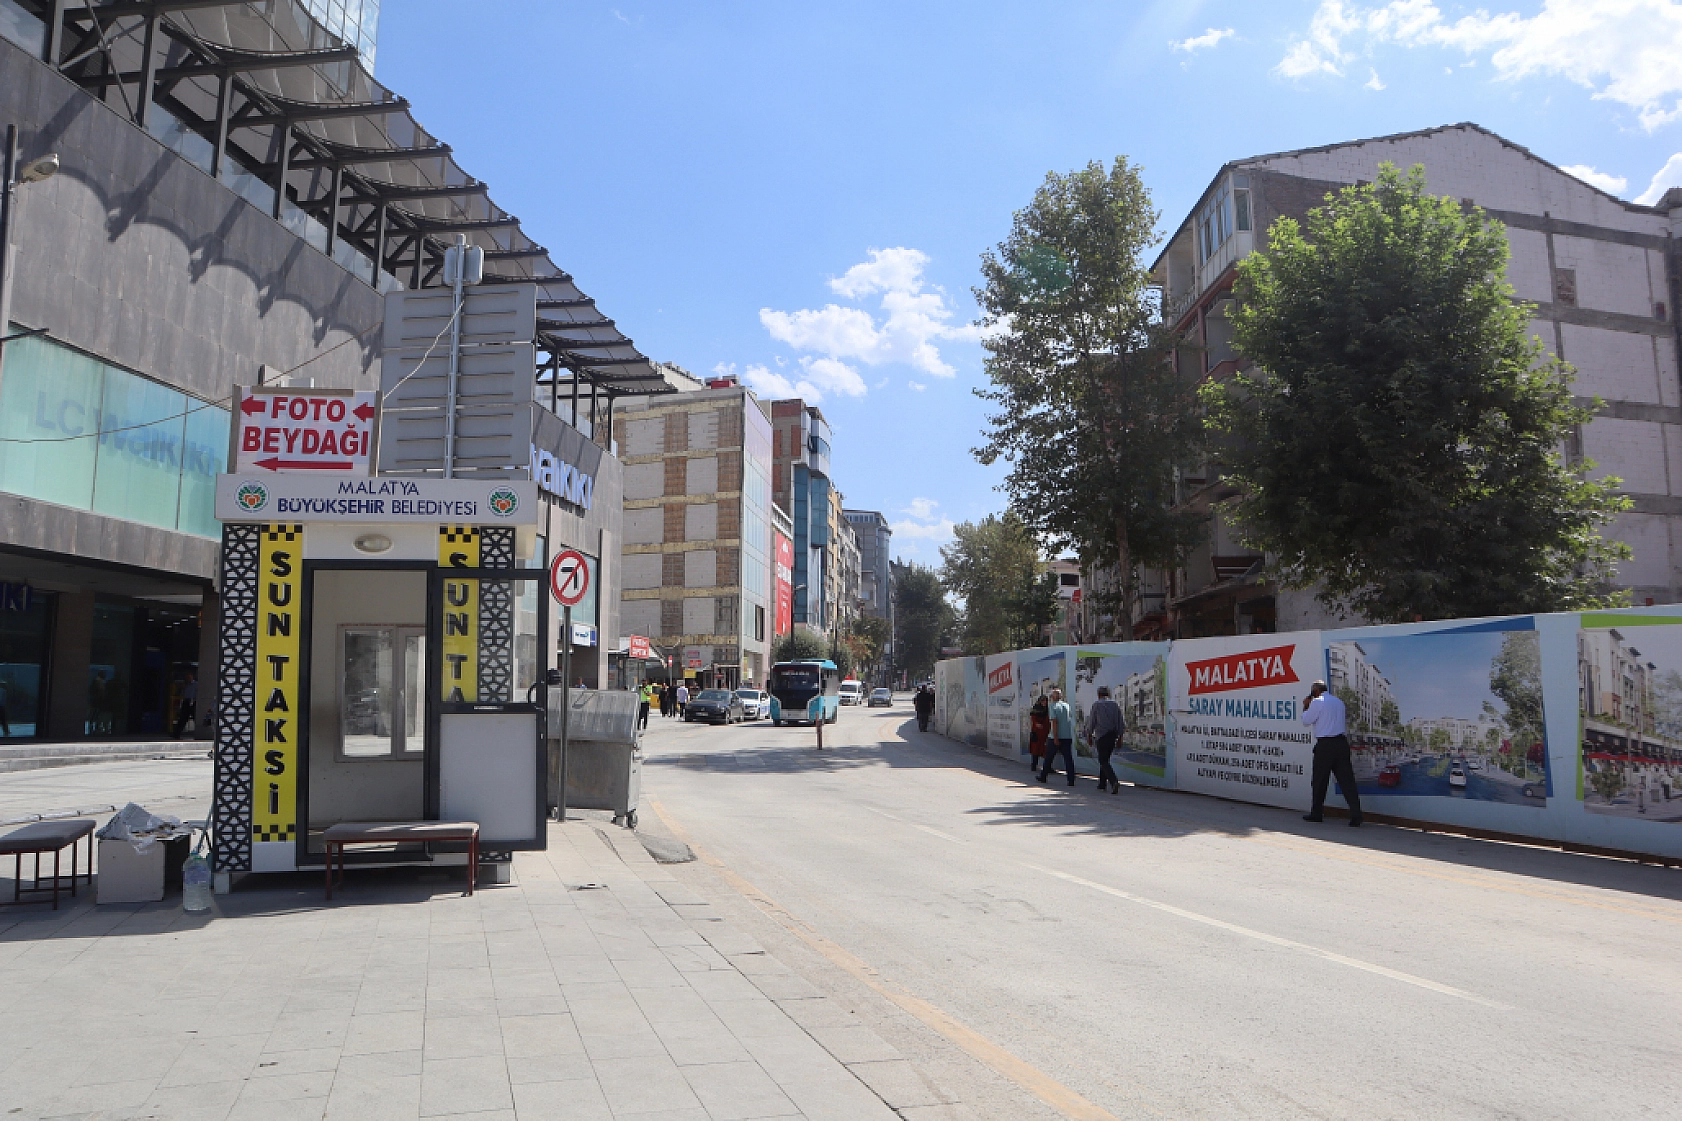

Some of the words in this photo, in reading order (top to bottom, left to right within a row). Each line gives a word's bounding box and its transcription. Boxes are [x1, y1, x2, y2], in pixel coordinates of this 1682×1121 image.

[36, 391, 85, 436] LC
[271, 396, 346, 422] FOTO
[242, 423, 370, 457] BEYDAĞI
[337, 480, 420, 496] MALATYA
[277, 498, 386, 516] BÜYÜKŞEHİR
[391, 499, 477, 516] BELEDİYESİ
[267, 550, 293, 637] SUN
[1195, 655, 1286, 688] MALATYA
[1188, 698, 1223, 716] SARAY
[1225, 696, 1297, 721] MAHALLESİ
[264, 655, 291, 815] TAKSİ
[1278, 732, 1312, 744] MAHALLESİ
